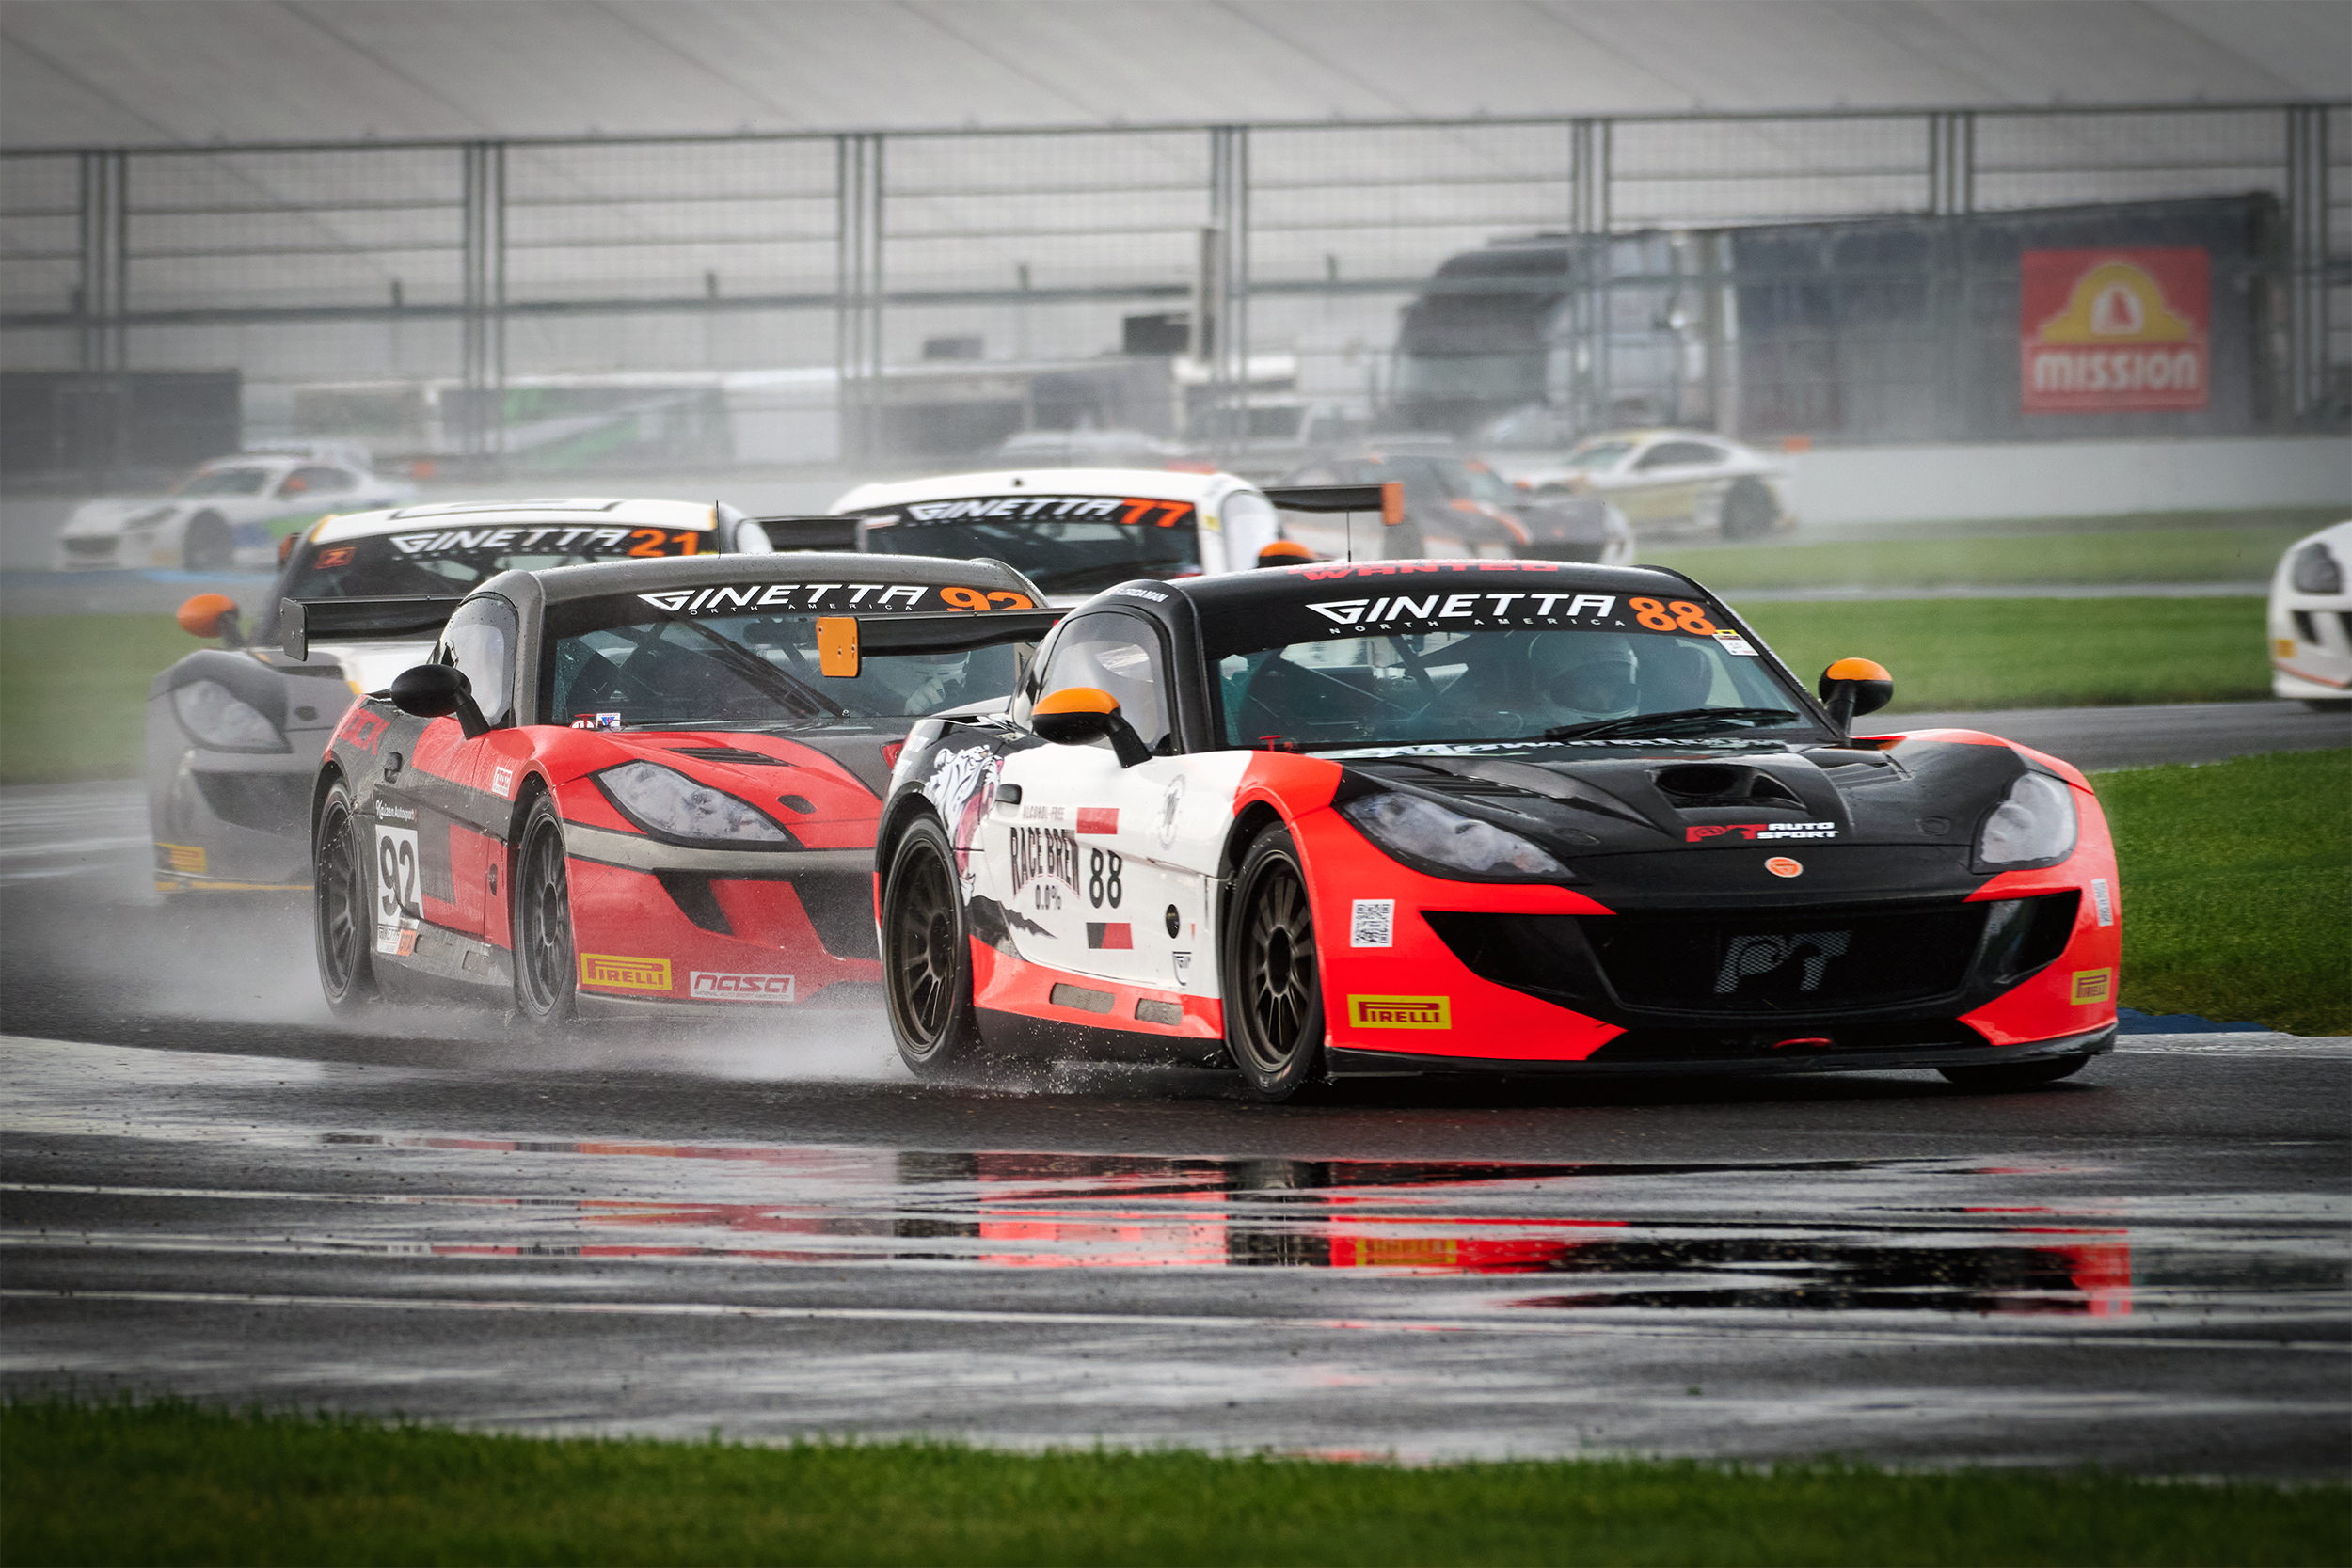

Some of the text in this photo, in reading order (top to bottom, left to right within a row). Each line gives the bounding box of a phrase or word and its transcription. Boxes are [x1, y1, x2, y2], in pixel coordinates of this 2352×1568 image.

[906, 498, 1123, 521] GINETTA
[1120, 497, 1196, 528] 77
[389, 528, 632, 554] GINETTA
[627, 528, 699, 558] 21
[1303, 562, 1559, 581] WANTED
[637, 584, 930, 611] GINETTA
[788, 603, 913, 611] AMERICA
[1305, 594, 1718, 636] GINETTA 88
[1329, 618, 1626, 635] NORTH AMERICA
[1756, 831, 1839, 840] SPORT
[1768, 821, 1835, 831] AUTO
[1010, 826, 1043, 896] RACE
[380, 835, 420, 917] 92
[1089, 847, 1122, 909] 88
[586, 958, 664, 985] PIRELLI
[1713, 929, 1853, 994] PT
[1358, 1001, 1440, 1023] PIRELLI
